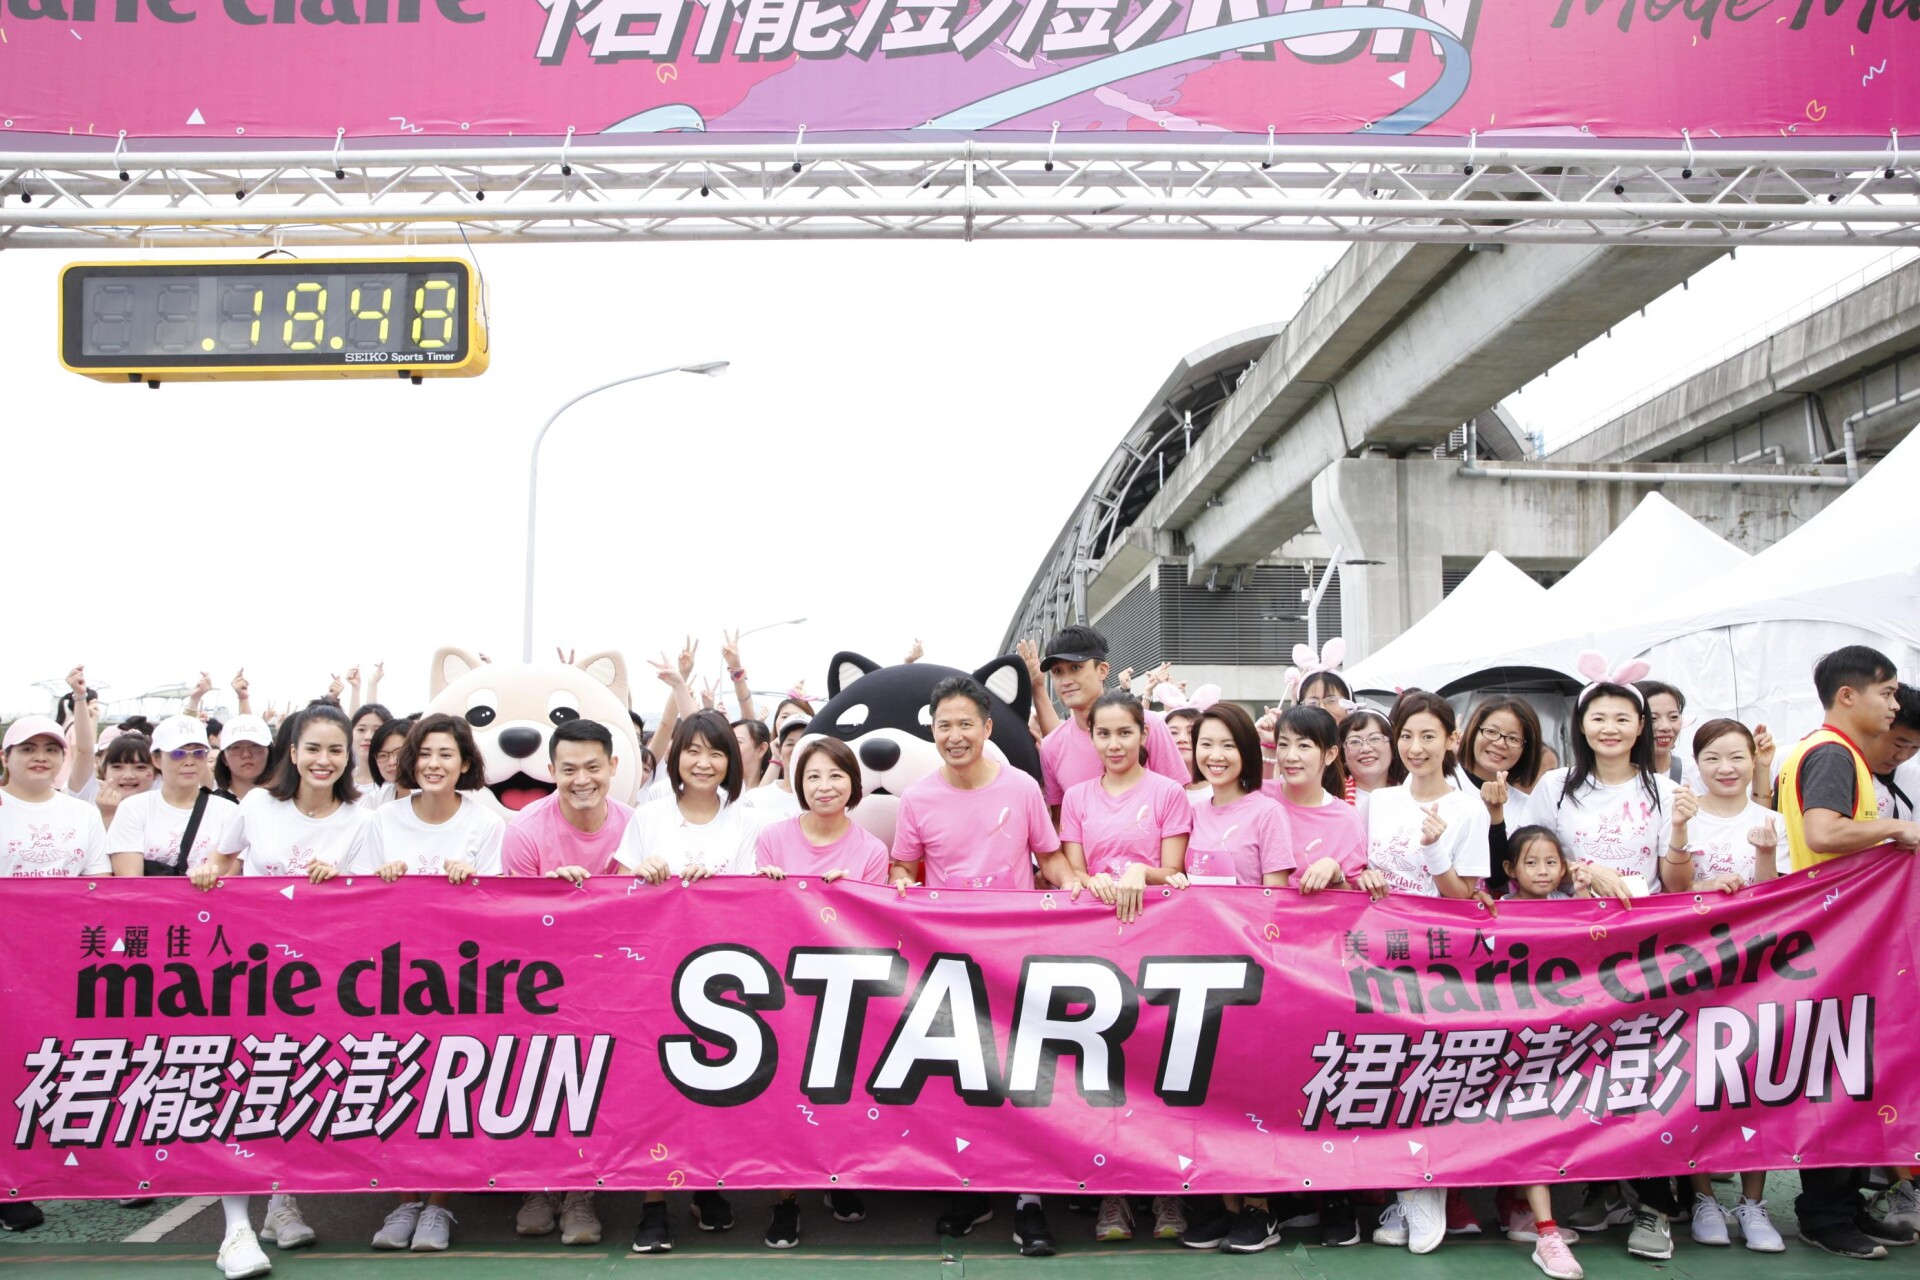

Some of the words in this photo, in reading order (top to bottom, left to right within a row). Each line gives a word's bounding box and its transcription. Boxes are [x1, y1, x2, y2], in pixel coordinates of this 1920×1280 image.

[345, 352, 388, 362] SEIKO
[391, 352, 424, 363] Sports
[427, 352, 455, 361] Timer
[1598, 824, 1622, 835] Pink
[30, 832, 55, 841] Pink
[1594, 834, 1622, 843] Run
[1708, 853, 1735, 865] Pink
[1708, 863, 1734, 873] Run
[1395, 876, 1423, 892] claire
[80, 924, 234, 959] 美麗佳人
[1349, 942, 1585, 1014] marie
[1598, 923, 1818, 1003] claire
[76, 943, 322, 1019] marie
[336, 940, 565, 1018] claire
[660, 944, 1262, 1107] START
